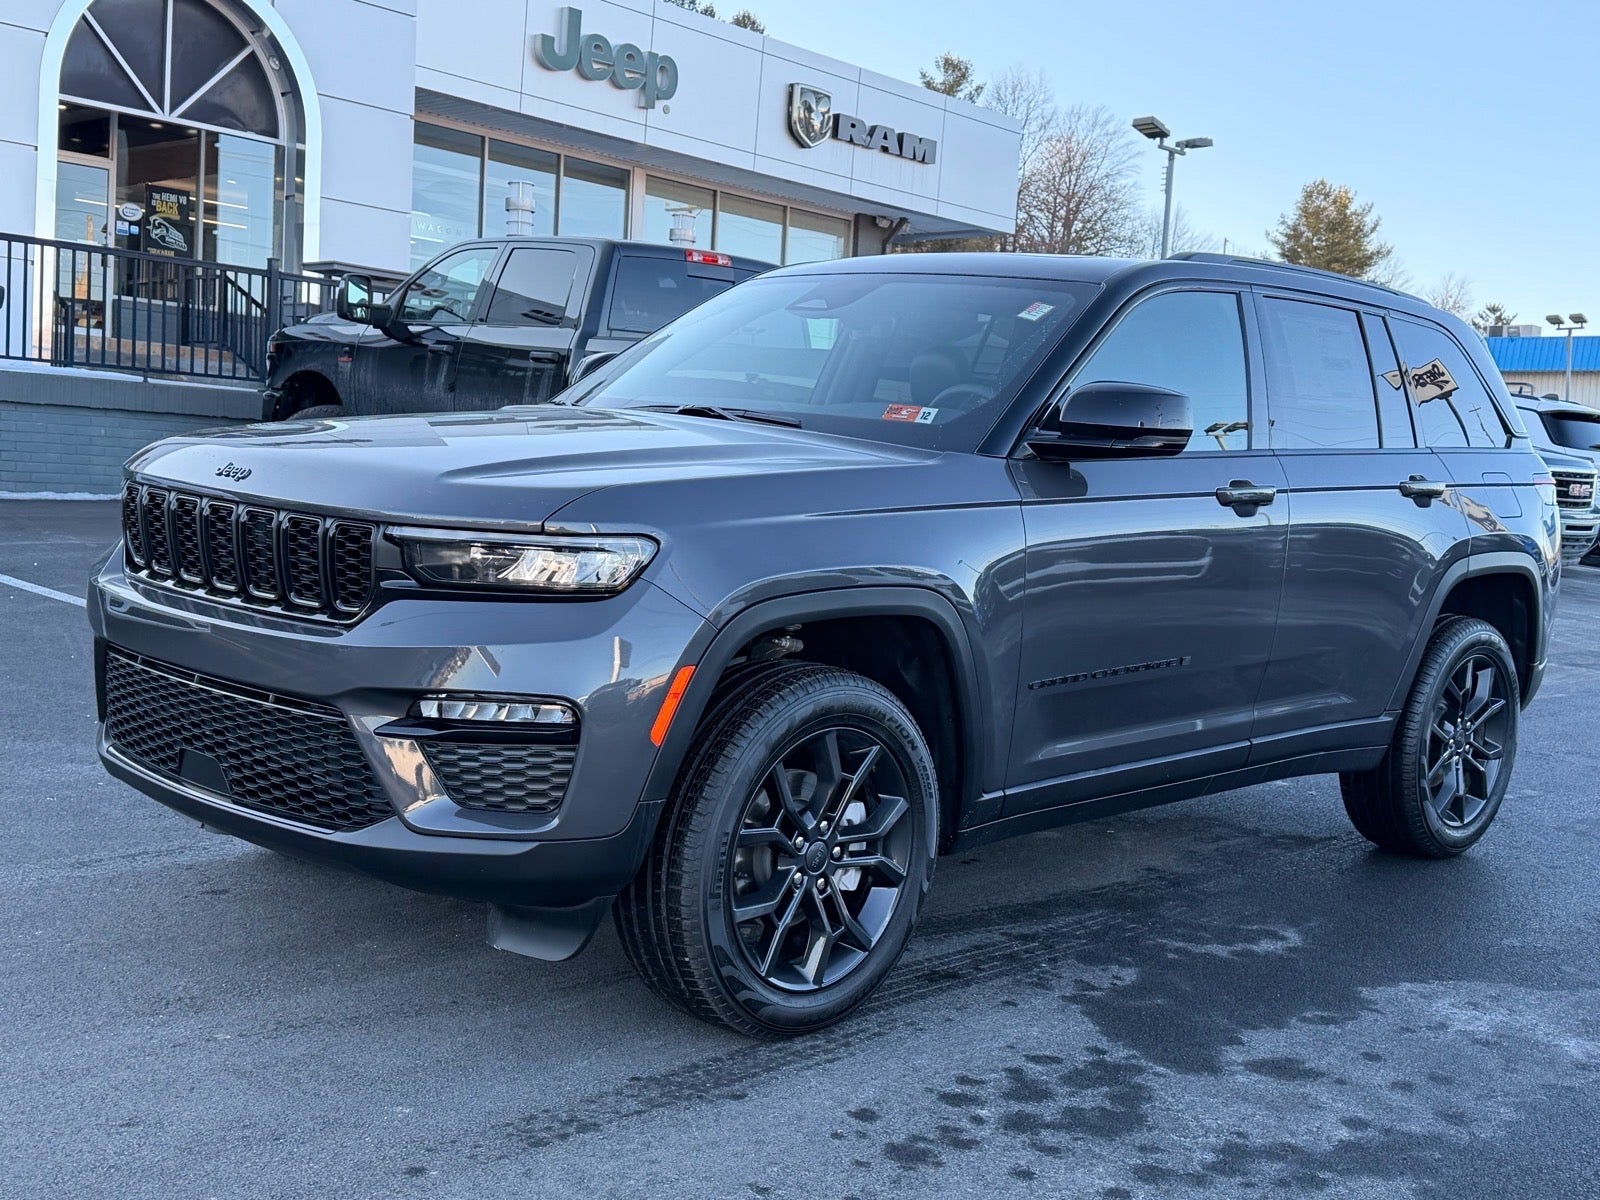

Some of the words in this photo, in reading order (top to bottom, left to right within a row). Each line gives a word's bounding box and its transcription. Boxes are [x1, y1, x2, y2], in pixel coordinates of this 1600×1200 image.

[534, 6, 678, 109] Jeep
[832, 113, 937, 164] RAM
[152, 192, 161, 200] THE
[161, 192, 178, 203] HEMI
[178, 195, 187, 205] V8
[156, 200, 178, 215] BACK
[920, 411, 931, 420] 12
[214, 461, 252, 482] Jeep
